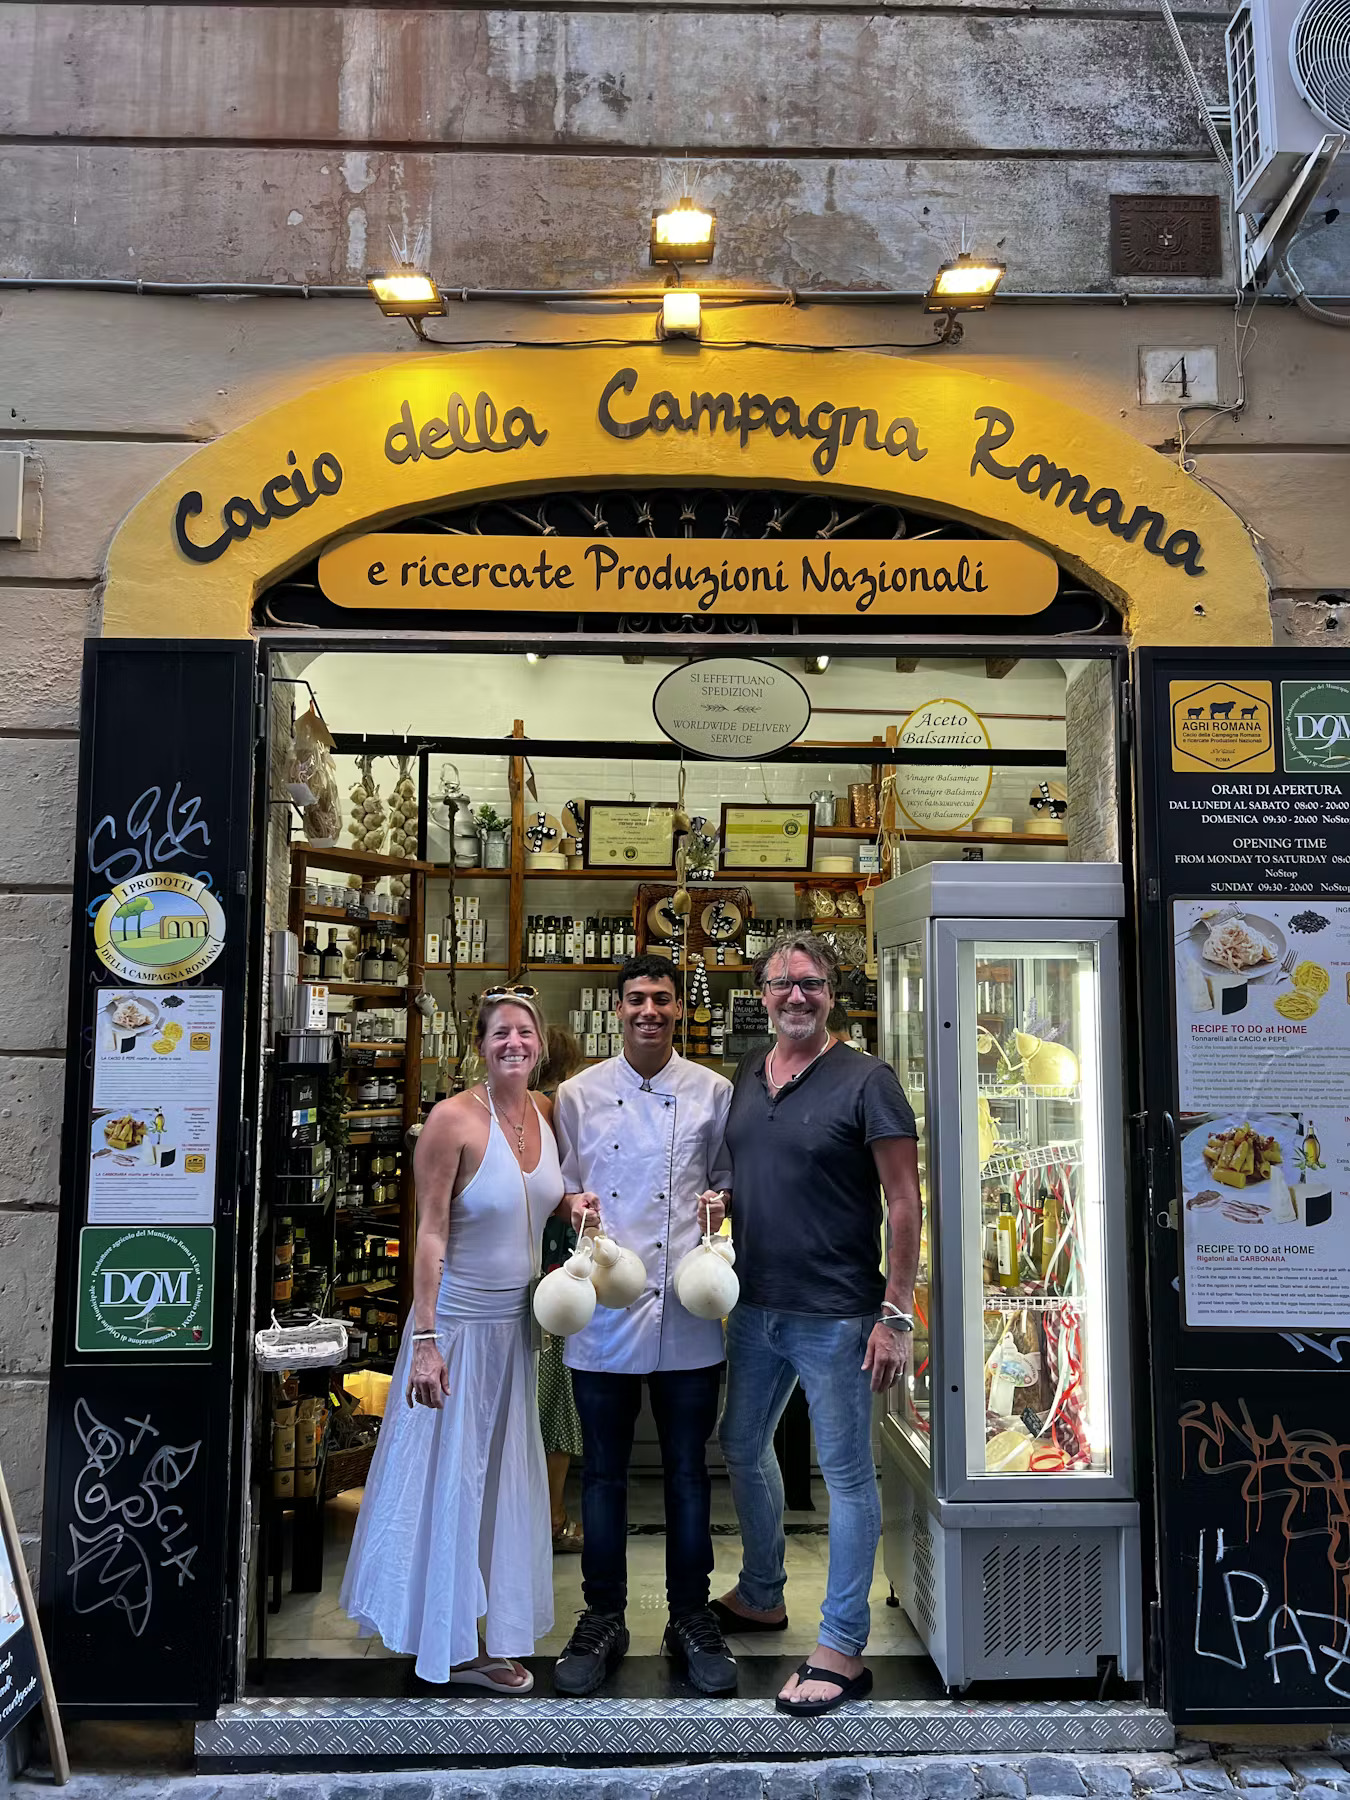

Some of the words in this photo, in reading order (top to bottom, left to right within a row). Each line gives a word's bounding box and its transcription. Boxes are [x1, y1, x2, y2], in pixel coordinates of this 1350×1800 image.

[1161, 354, 1197, 398] 4
[175, 450, 343, 564] Cacio
[384, 391, 548, 464] della
[599, 368, 927, 475] Campagna
[970, 406, 1205, 575] Romana
[367, 560, 388, 585] e
[401, 549, 575, 590] ricercate
[585, 544, 790, 610] Produzioni
[803, 552, 988, 611] Nazionali
[690, 673, 700, 683] SI
[703, 674, 775, 686] EFFETTUANO
[701, 686, 763, 698] SPEDIZIONI
[673, 720, 737, 731] WORLDWIDE
[742, 722, 791, 733] DELIVERY
[915, 713, 968, 728] Aceto
[1182, 721, 1209, 731] AGRI
[1212, 721, 1262, 731] ROMANA
[711, 734, 752, 744] SERVICE
[902, 731, 982, 744] Balsamico
[905, 774, 935, 783] Vinagre
[936, 774, 980, 783] Balsamique
[1211, 784, 1253, 795] ORARI
[1255, 784, 1270, 795] DI
[1272, 784, 1342, 795] APERTURA
[1169, 801, 1190, 810] DAL
[1192, 801, 1232, 810] LUNEDI
[1233, 801, 1248, 810] AL
[1249, 801, 1290, 810] SABATO
[1294, 801, 1319, 810] 08:00
[1325, 801, 1350, 810] 20:00
[911, 811, 931, 819] Essig
[933, 811, 970, 819] Balsamico
[1201, 814, 1259, 824] DOMENICA
[1262, 815, 1288, 824] 09:30
[1293, 815, 1318, 824] 20:00
[1322, 814, 1350, 825] NoSto
[1232, 838, 1292, 849] OPENING
[1294, 838, 1327, 849] TIME
[1174, 855, 1205, 864] FROM
[1207, 855, 1253, 864] MONDAY
[1255, 855, 1271, 864] TO
[1272, 855, 1327, 864] SATURDAY
[1332, 855, 1350, 864] 08:0
[1265, 869, 1298, 879] NoStop
[121, 888, 129, 897] I
[129, 877, 195, 894] PRODOTTI
[1211, 883, 1254, 892] SUNDAY
[1258, 883, 1283, 892] 09:30
[1289, 883, 1314, 892] 20:00
[101, 948, 128, 974] DELLA
[128, 969, 185, 981] CAMPAGNA
[185, 943, 221, 975] ROMANA
[1191, 1024, 1228, 1033] RECIPE
[1231, 1024, 1245, 1033] TO
[1247, 1025, 1263, 1033] DO
[1266, 1025, 1275, 1034] at
[1278, 1025, 1307, 1034] HOME
[112, 1233, 135, 1249] agricolo
[146, 1230, 178, 1244] Municipio
[177, 1238, 192, 1256] Roma
[1197, 1245, 1234, 1253] RECIPE
[1237, 1245, 1251, 1254] TO
[1254, 1245, 1269, 1254] DO
[1272, 1246, 1281, 1254] at
[1284, 1246, 1315, 1254] HOME
[91, 1247, 113, 1277] Produttore
[190, 1255, 198, 1264] IX
[193, 1264, 201, 1275] Eur
[89, 1285, 104, 1321] Municipale
[192, 1284, 204, 1311] Marchio
[181, 1311, 197, 1328] DOM
[100, 1319, 121, 1339] Origine
[128, 1329, 177, 1346] Denominazione
